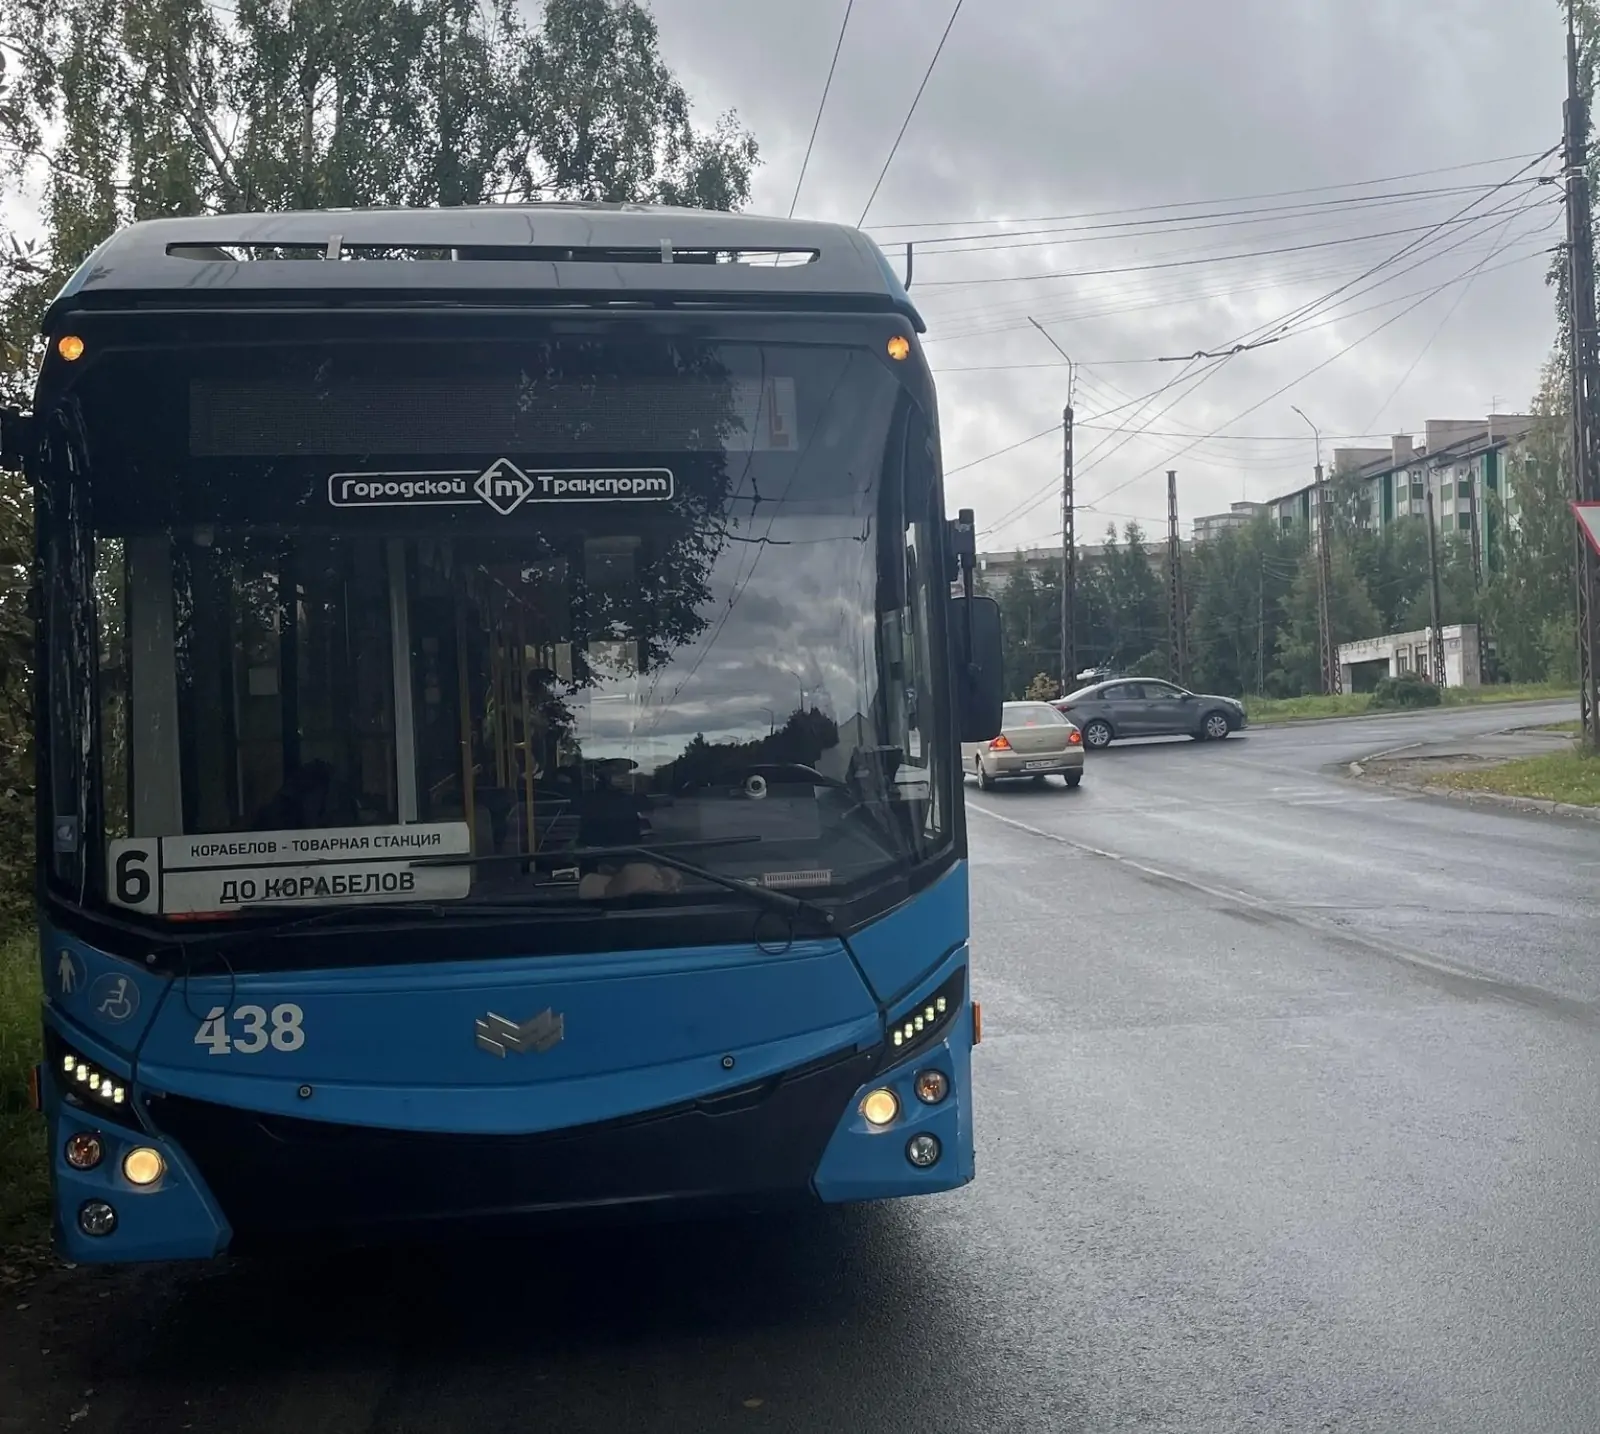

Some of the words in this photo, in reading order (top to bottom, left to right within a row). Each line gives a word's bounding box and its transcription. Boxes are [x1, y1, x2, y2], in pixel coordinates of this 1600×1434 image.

[342, 477, 466, 499] Городской
[538, 475, 667, 495] Транспорт
[191, 840, 277, 857] КОРАБЕЛОВ
[291, 836, 369, 852] ТОВАРНАЯ
[373, 833, 441, 849] СТАНЦИЯ
[116, 850, 150, 904] 6
[220, 880, 256, 904] ДО
[265, 872, 415, 899] КОРАБЕЛОВ
[194, 1003, 305, 1055] 438
